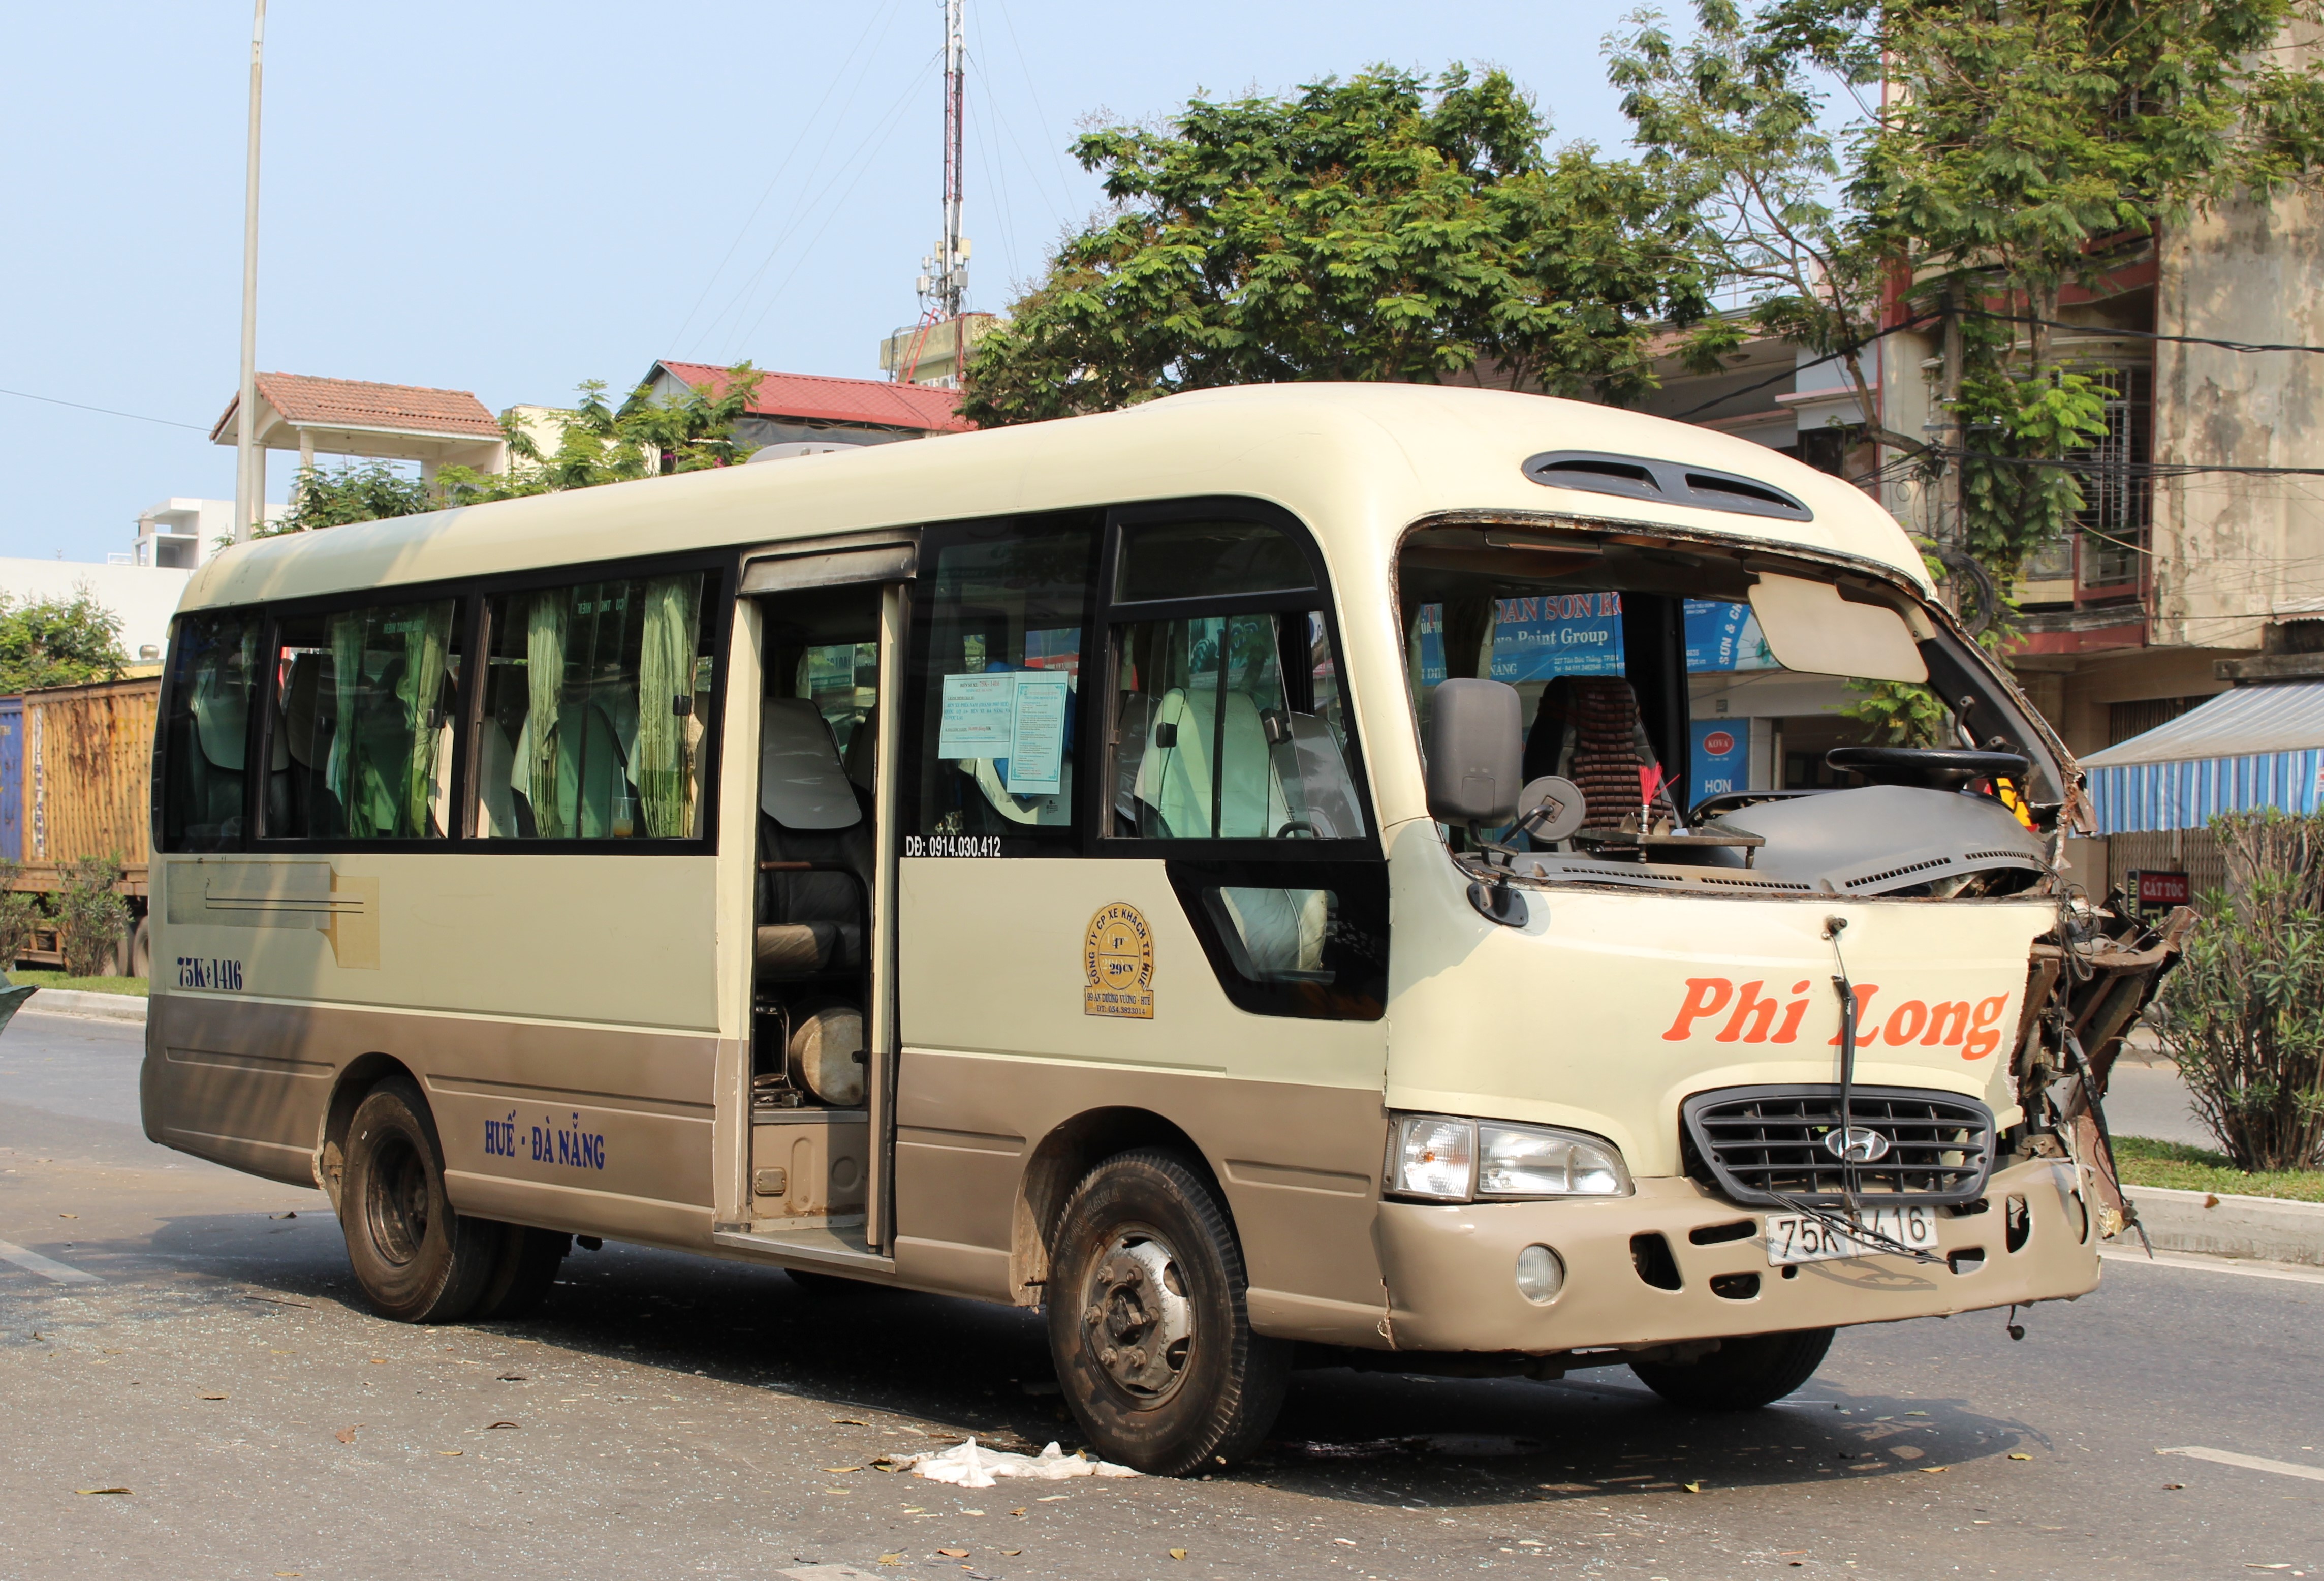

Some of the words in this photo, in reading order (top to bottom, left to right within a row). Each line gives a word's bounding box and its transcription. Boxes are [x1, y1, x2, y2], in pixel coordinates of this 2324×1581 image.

[1561, 628, 1608, 646] Group
[1708, 739, 1729, 748] KOVA
[929, 836, 1001, 857] 0914.030.412
[2143, 876, 2163, 896] CẮT
[1089, 931, 1097, 946] TY
[1096, 915, 1106, 931] CP
[1108, 908, 1118, 920] XE
[1121, 908, 1146, 939] KHÁCH
[1087, 993, 1093, 1001] 99
[1661, 977, 1811, 1044] Phi
[1827, 982, 2011, 1062] Long
[485, 1109, 516, 1158] HUẾ
[532, 1115, 555, 1164] ĐÀ
[558, 1111, 605, 1170] NẴNG
